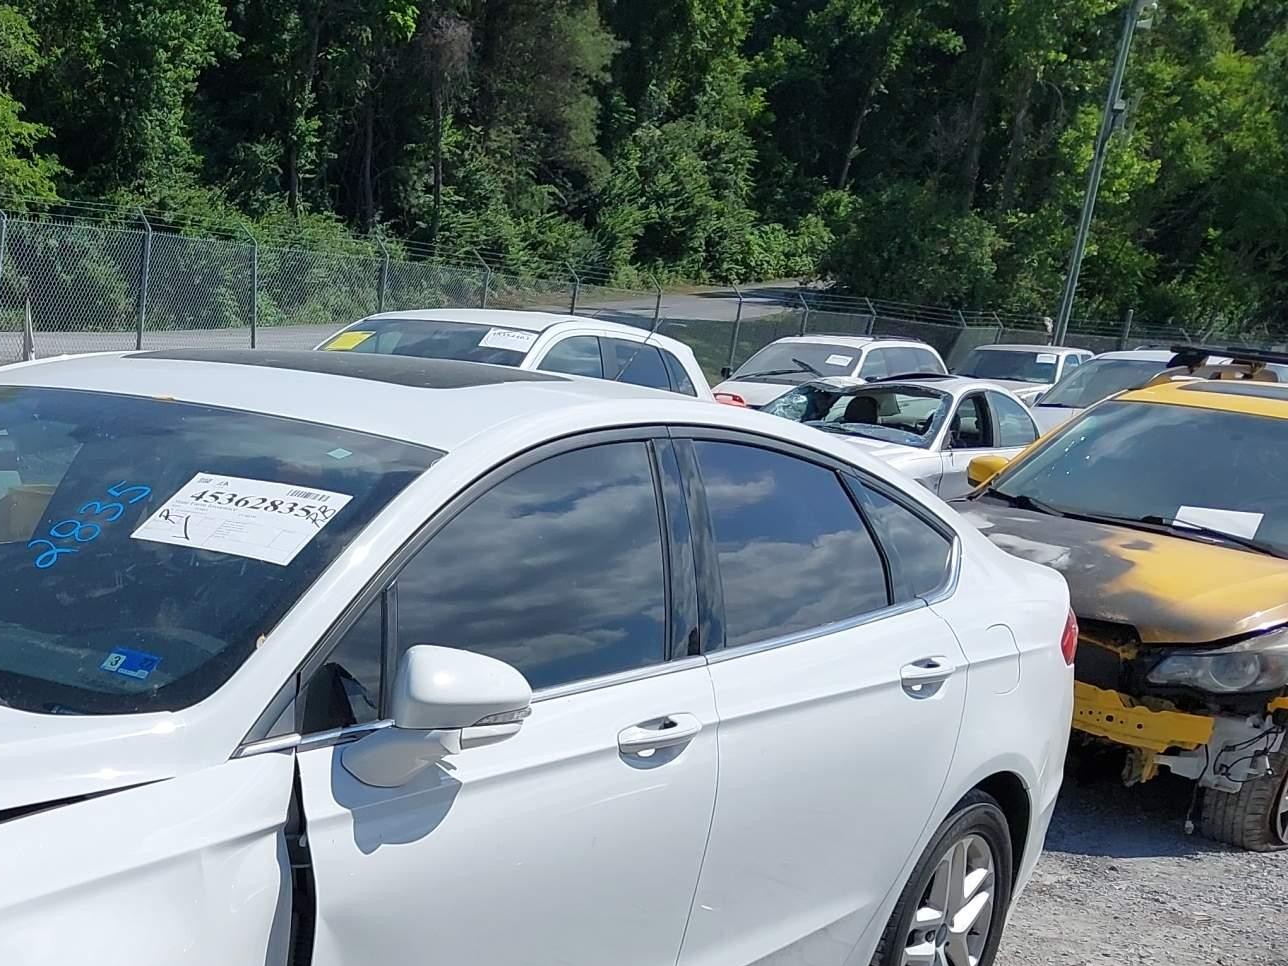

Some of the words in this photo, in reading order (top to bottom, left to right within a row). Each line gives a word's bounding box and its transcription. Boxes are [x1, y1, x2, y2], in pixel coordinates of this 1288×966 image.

[190, 490, 316, 517] 45362835
[28, 479, 152, 568] 2835
[110, 655, 121, 666] 3
